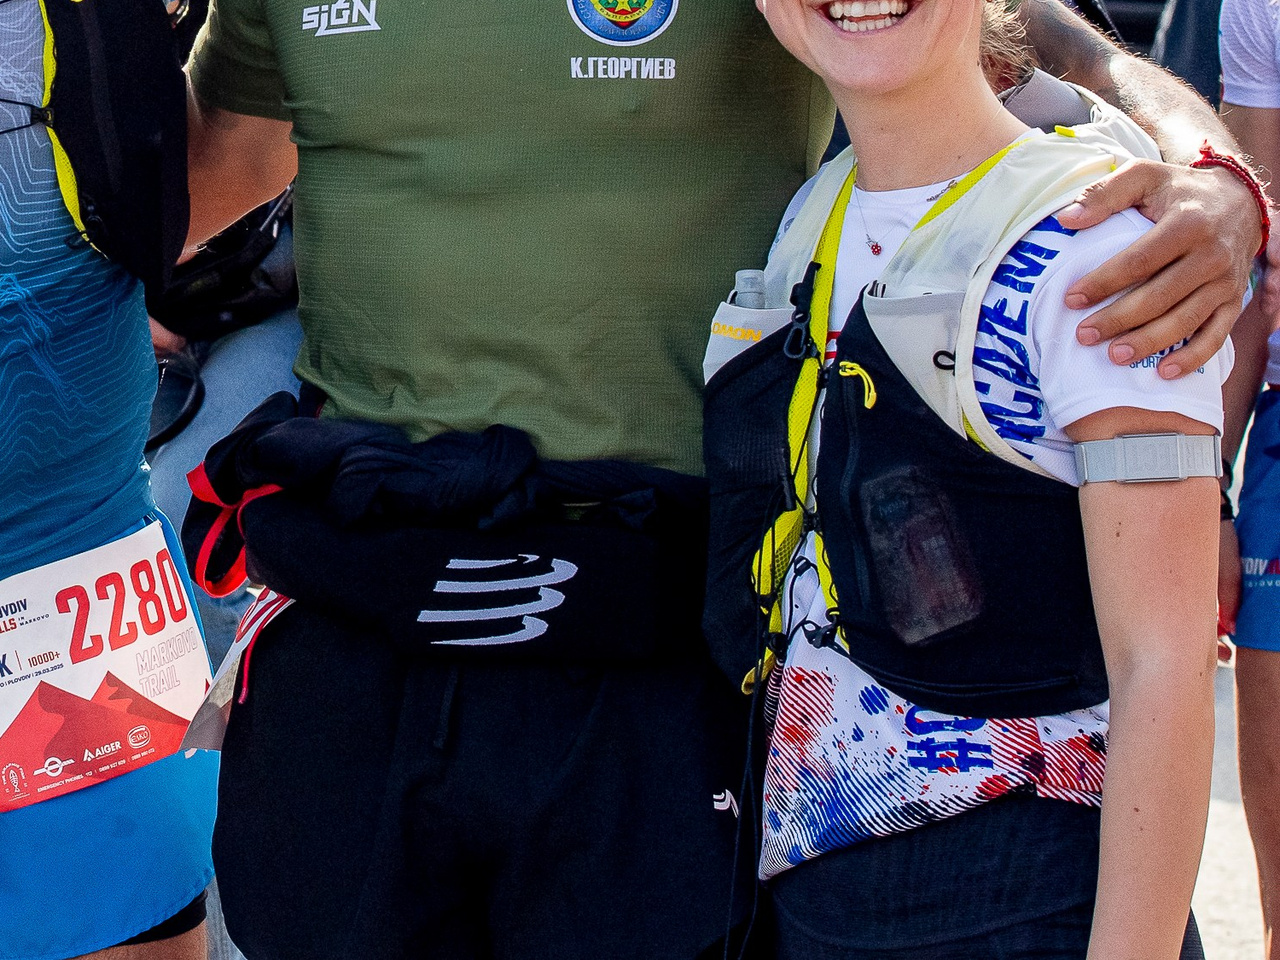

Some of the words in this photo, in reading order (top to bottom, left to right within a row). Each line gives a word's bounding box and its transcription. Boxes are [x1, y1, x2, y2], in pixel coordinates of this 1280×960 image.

[570, 56, 676, 79] К.ГЕОРГИЕВ
[55, 548, 188, 665] 2280
[20, 613, 50, 626] MARKOVO
[27, 651, 61, 668] 1000D+
[135, 626, 199, 676] MARKOVO
[7, 673, 31, 686] PLOVDIV
[139, 664, 181, 700] TRAIL
[95, 740, 122, 758] AIGER
